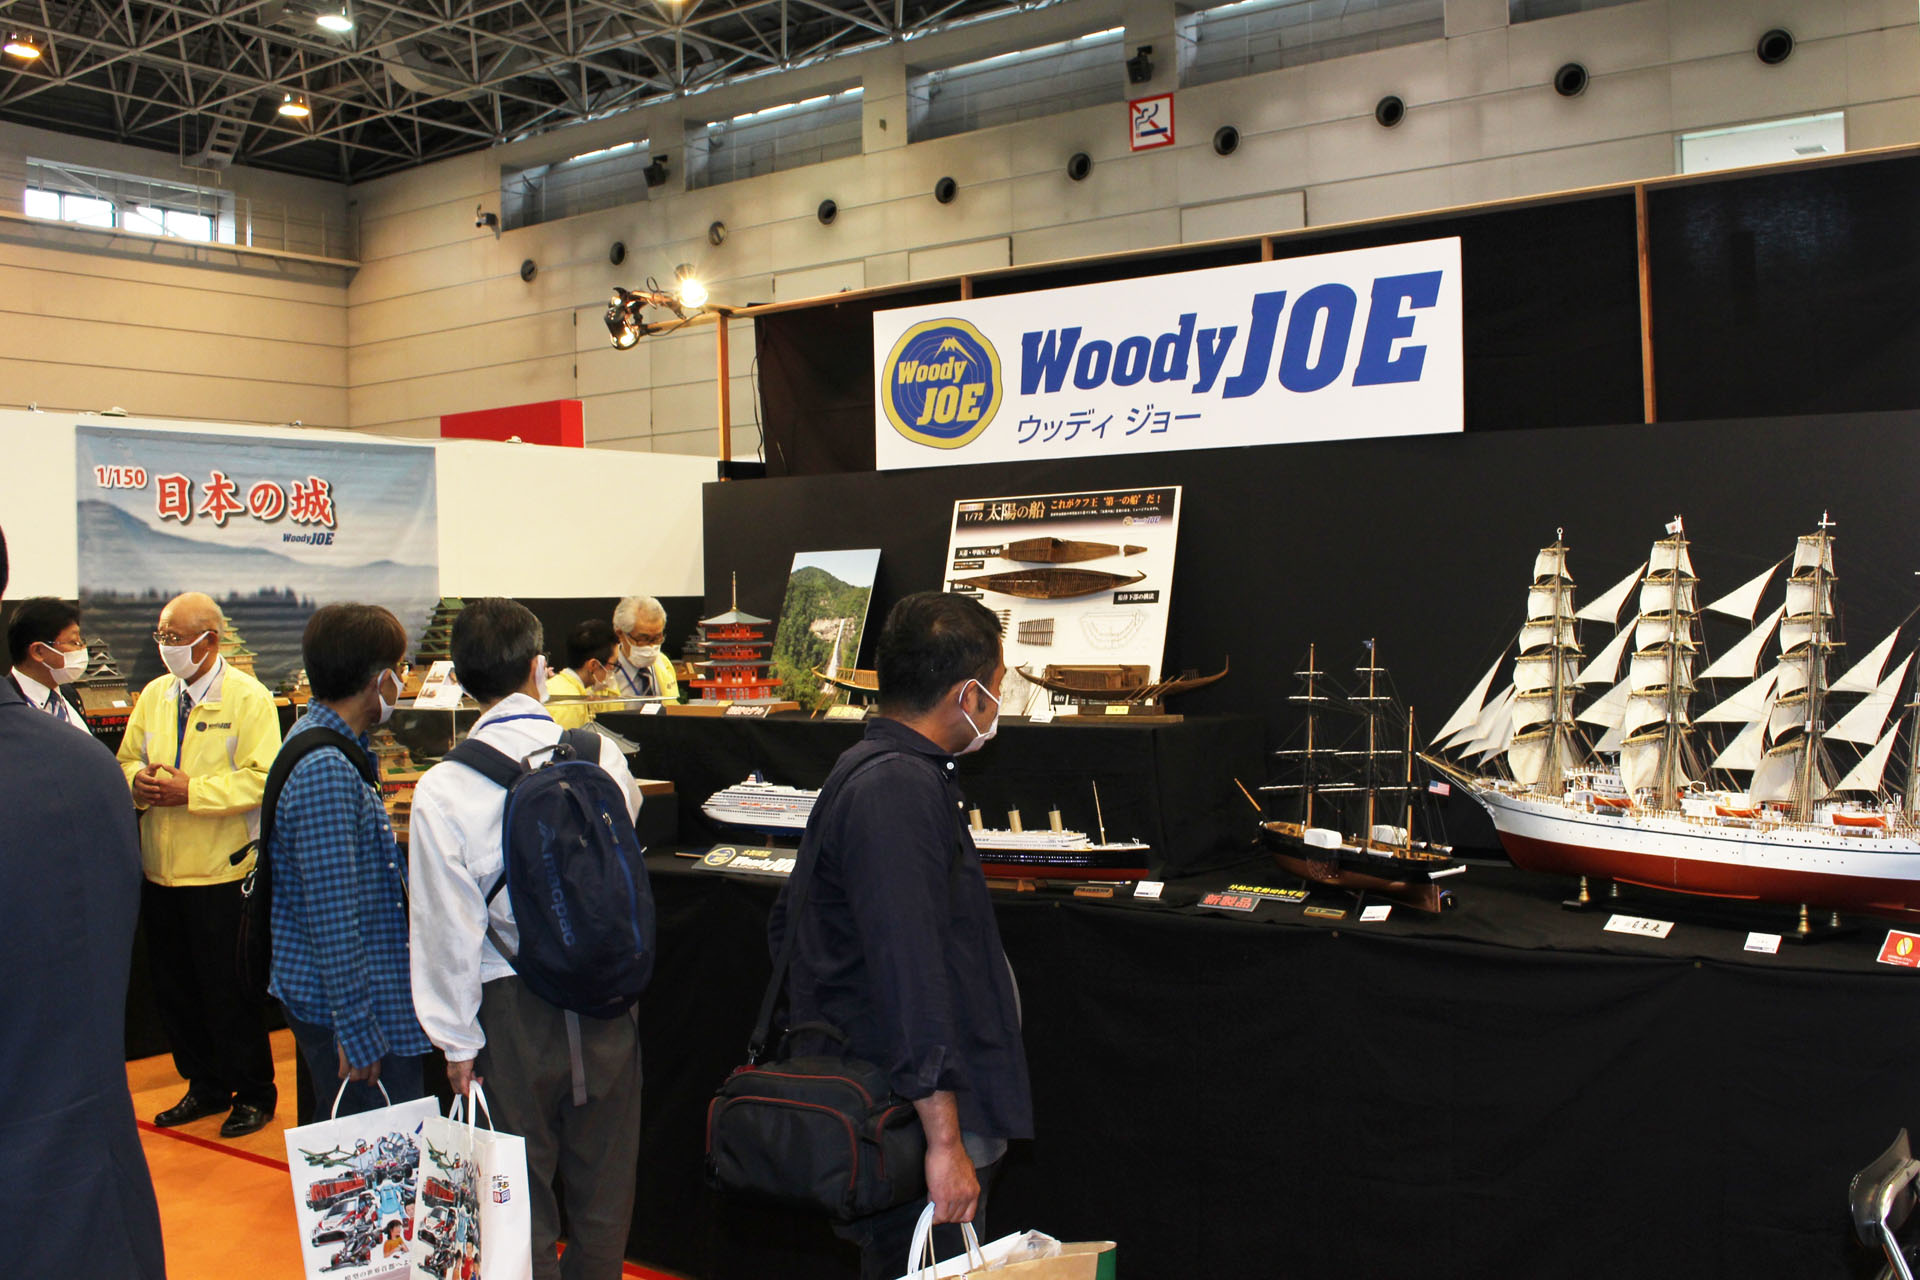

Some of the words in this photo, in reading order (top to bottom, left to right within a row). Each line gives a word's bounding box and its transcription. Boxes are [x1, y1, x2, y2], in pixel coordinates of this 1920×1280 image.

[1021, 270, 1443, 399] WoodyJOE
[898, 355, 968, 386] Woody
[916, 384, 984, 426] JOE
[1017, 411, 1114, 444] ウッディ
[1125, 403, 1201, 436] ジョー
[95, 466, 147, 488] 1/150
[156, 471, 335, 527] 日本の城
[965, 512, 984, 521] 1/72
[985, 501, 1046, 522] 太陽の船
[1203, 894, 1253, 909] 新製品
